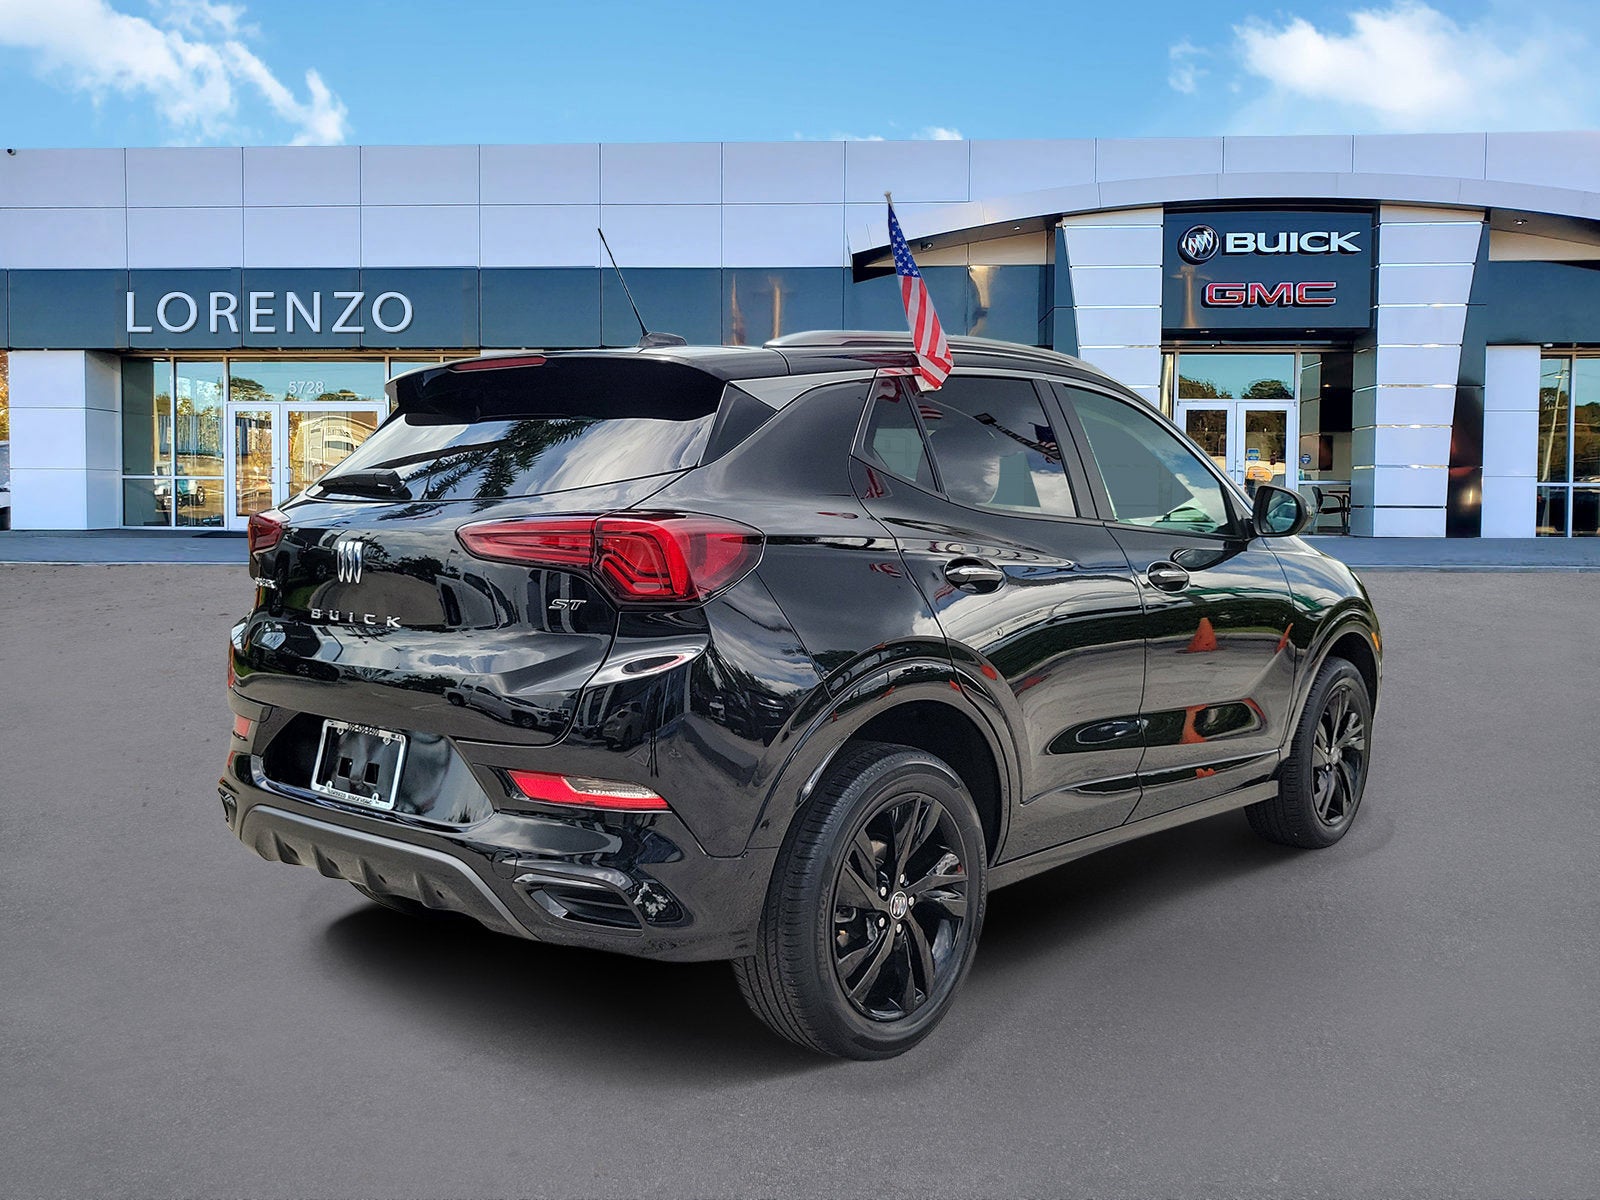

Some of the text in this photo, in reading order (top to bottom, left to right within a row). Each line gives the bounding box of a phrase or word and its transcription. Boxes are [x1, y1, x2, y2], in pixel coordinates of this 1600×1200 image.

[1225, 231, 1362, 253] BUICK
[1205, 281, 1337, 306] GMC
[126, 291, 414, 333] LORENZO
[288, 381, 325, 394] 5728
[548, 598, 587, 610] ST
[310, 608, 402, 628] BUICK
